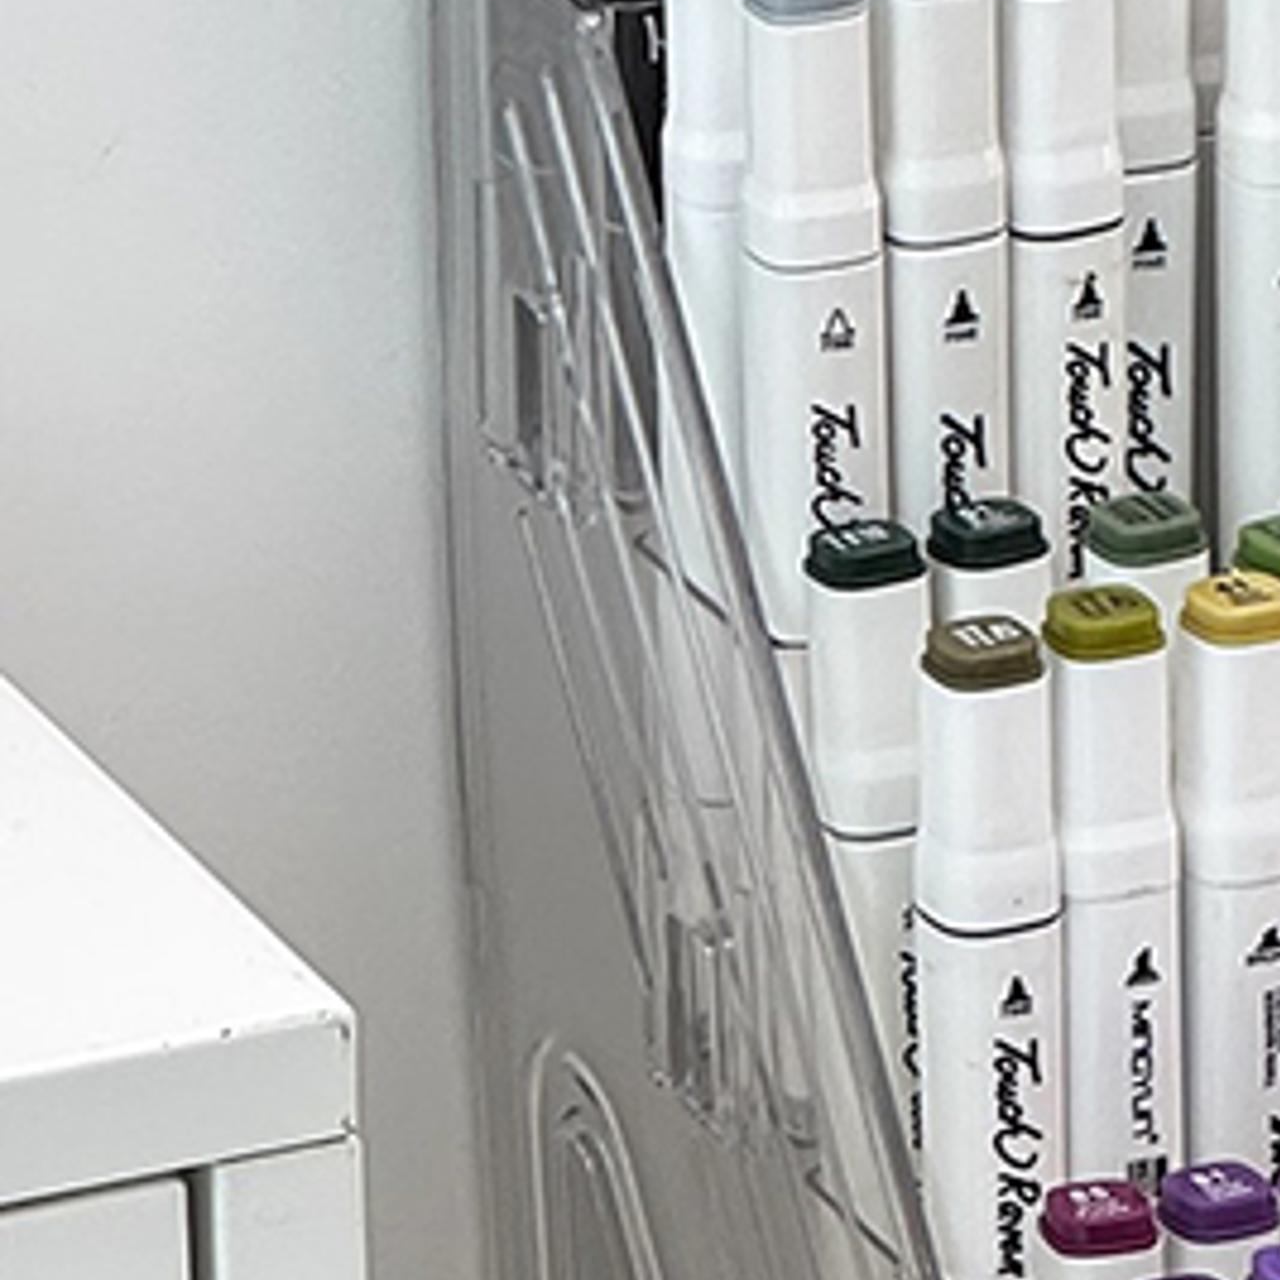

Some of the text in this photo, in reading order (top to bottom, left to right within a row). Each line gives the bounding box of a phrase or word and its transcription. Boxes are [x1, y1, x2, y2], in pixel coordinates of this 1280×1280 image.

[1064, 340, 1112, 474] Touch
[1124, 342, 1173, 494] Touch
[992, 1036, 1044, 1172] Touch
